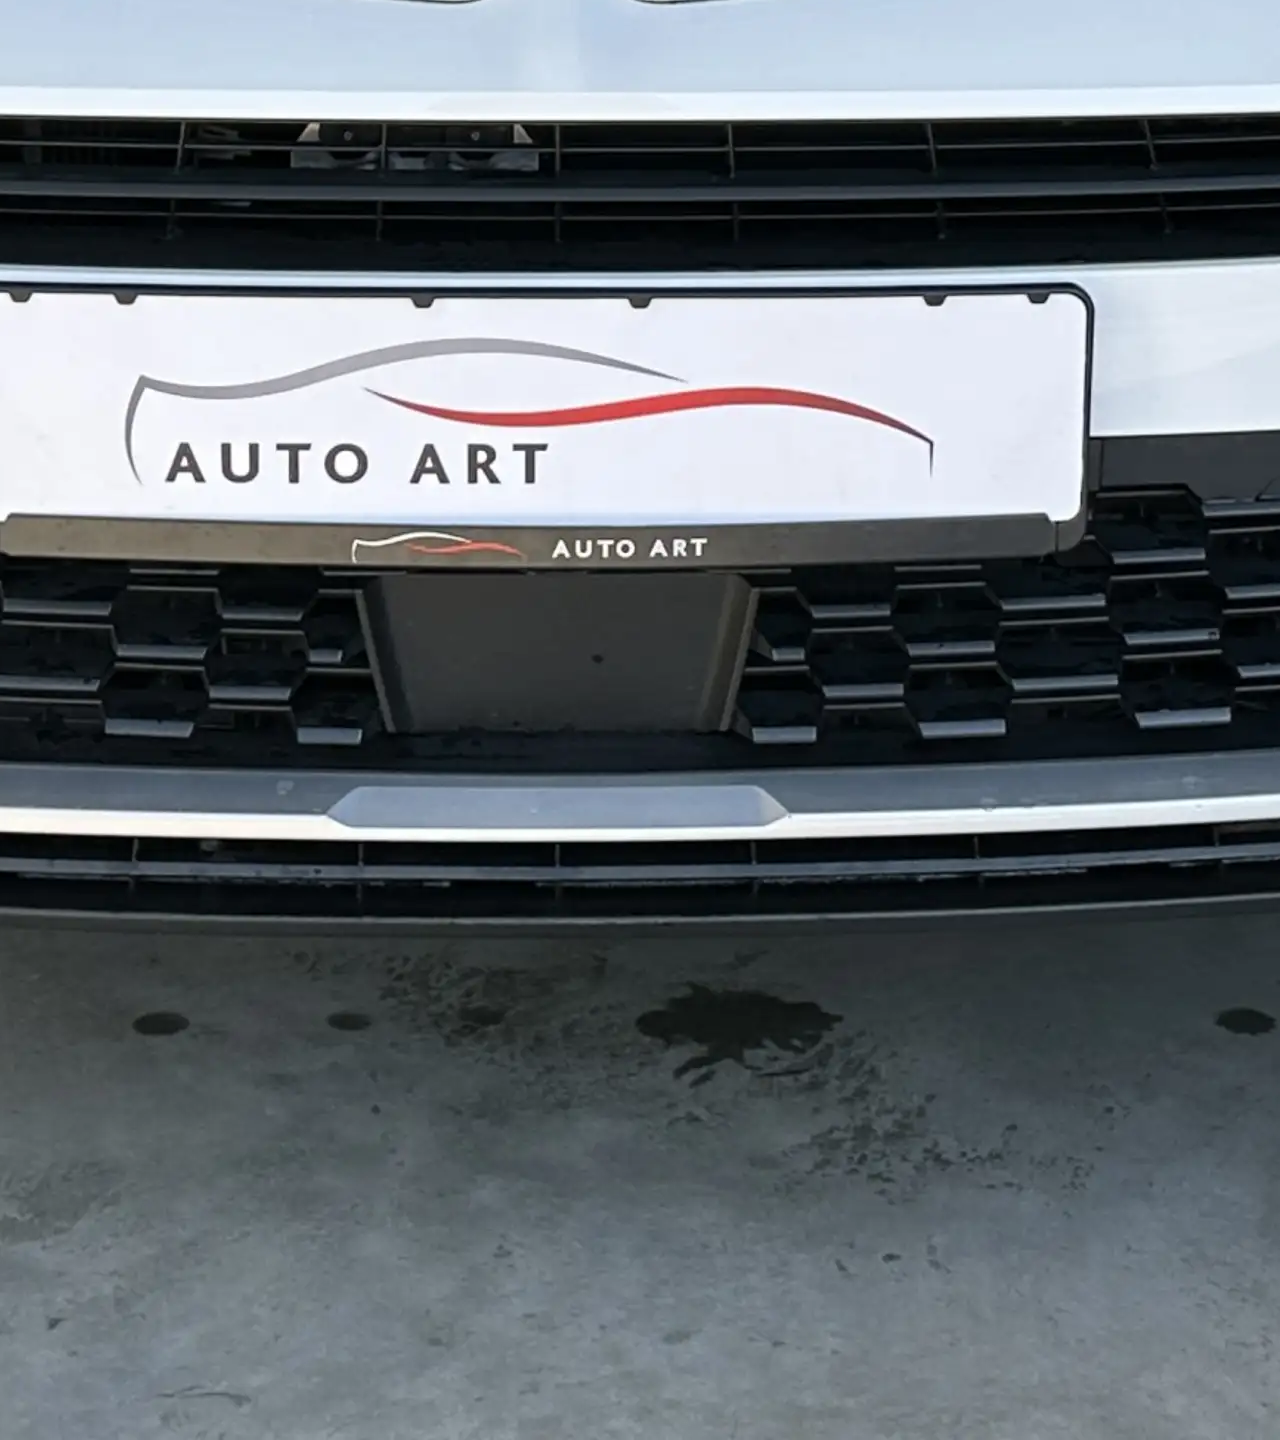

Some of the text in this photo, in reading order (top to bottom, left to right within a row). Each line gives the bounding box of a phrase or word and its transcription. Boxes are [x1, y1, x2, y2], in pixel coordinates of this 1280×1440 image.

[164, 441, 549, 485] AUTO ART
[551, 537, 708, 559] AUTO ART
